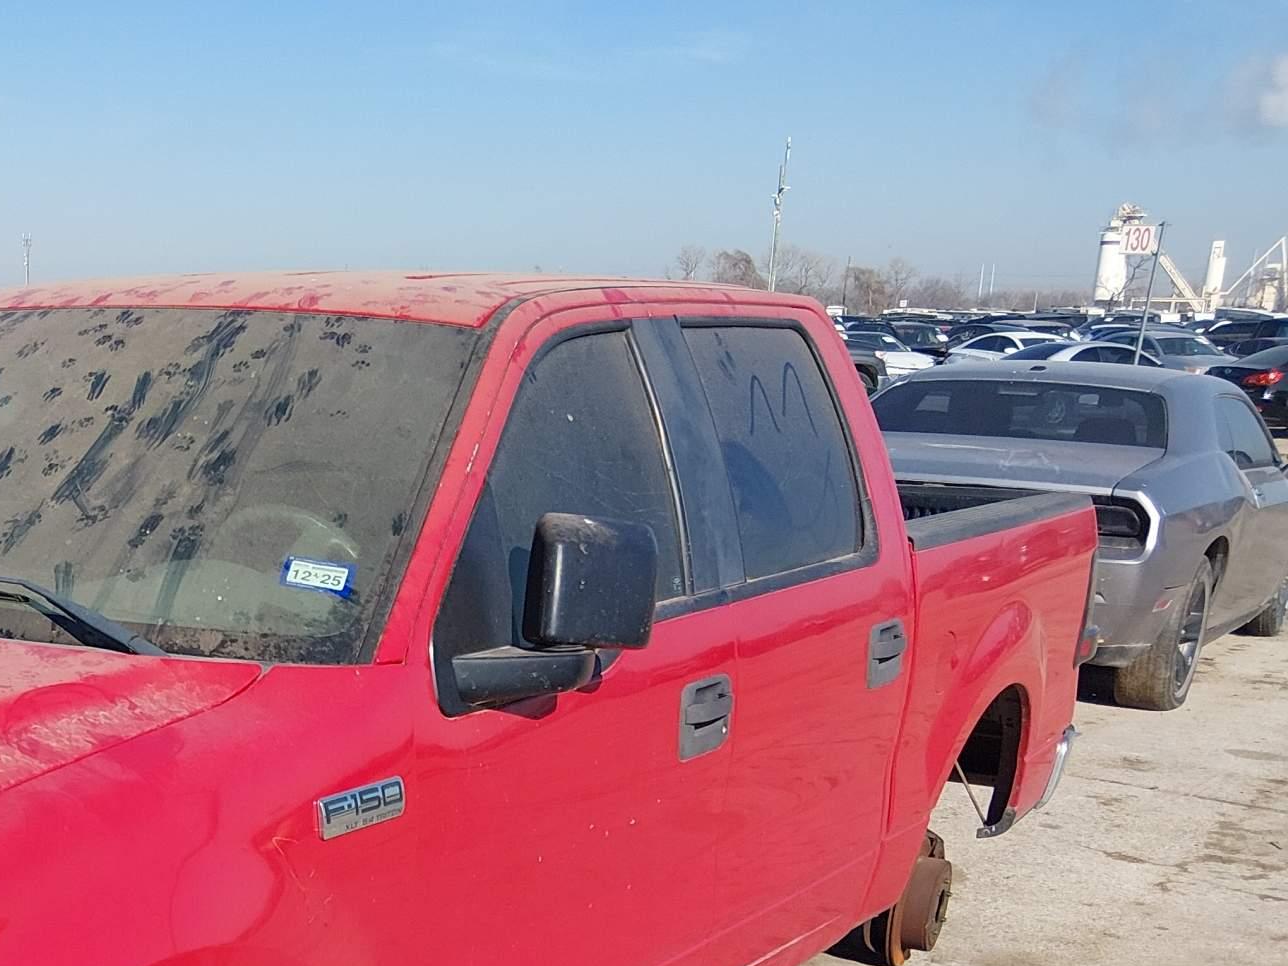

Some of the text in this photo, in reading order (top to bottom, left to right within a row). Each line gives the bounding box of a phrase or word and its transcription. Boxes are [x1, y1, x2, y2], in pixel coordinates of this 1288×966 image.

[1124, 227, 1151, 252] 130
[292, 569, 343, 587] 12 25
[323, 781, 404, 825] F-150
